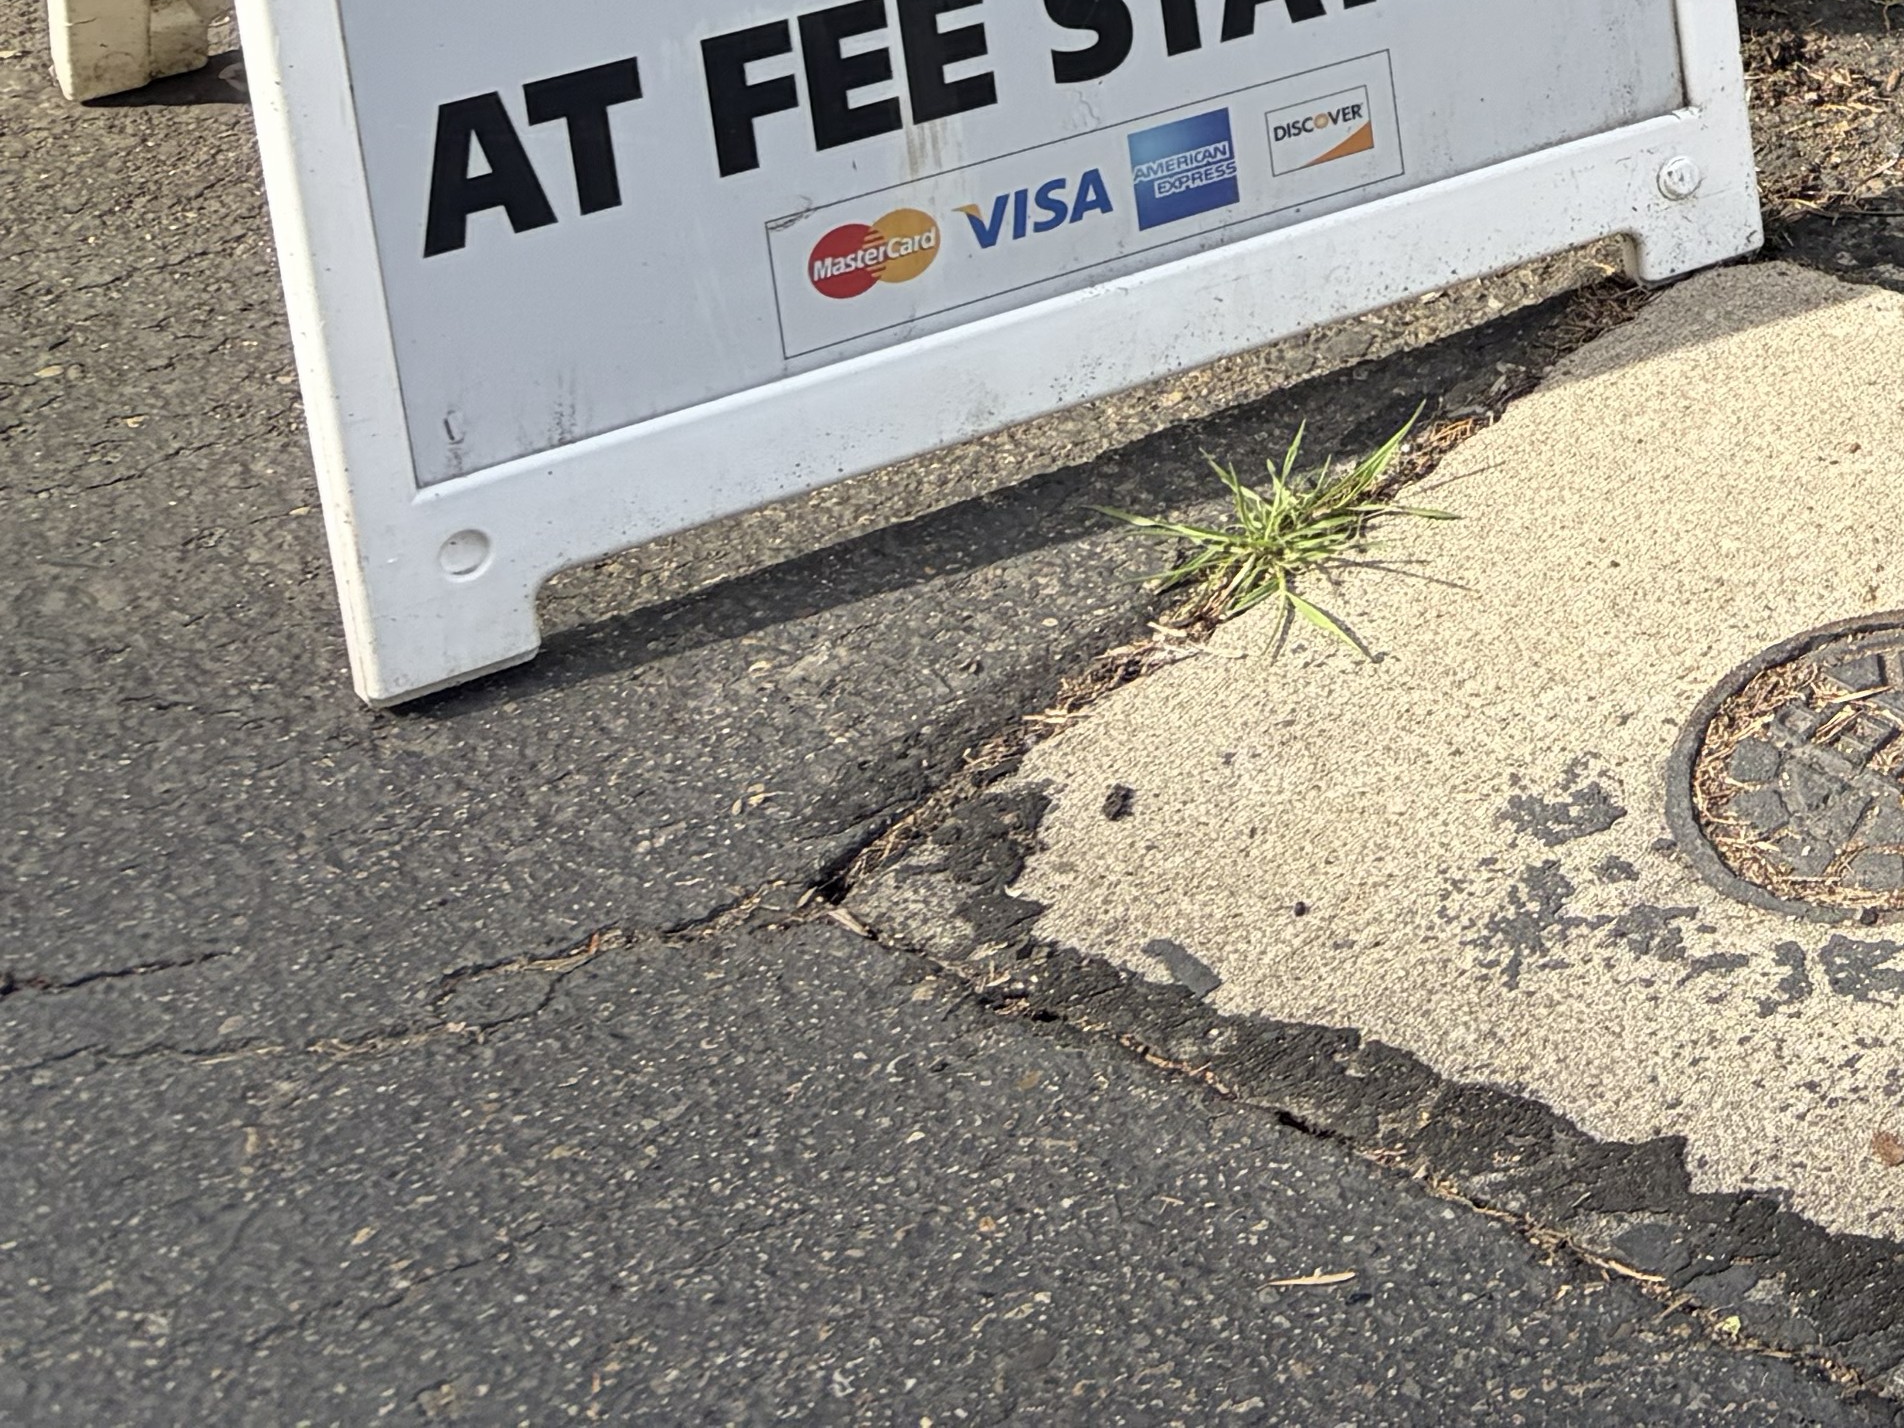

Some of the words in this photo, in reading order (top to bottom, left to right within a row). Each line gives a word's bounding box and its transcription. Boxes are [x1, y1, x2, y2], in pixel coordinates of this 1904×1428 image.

[1274, 104, 1363, 142] DISCOVER
[424, 57, 642, 257] AT
[1133, 143, 1228, 180] AMERICAN
[1156, 162, 1237, 195] EXPRESS
[951, 168, 1113, 249] VISA
[813, 225, 936, 281] MasterCard
